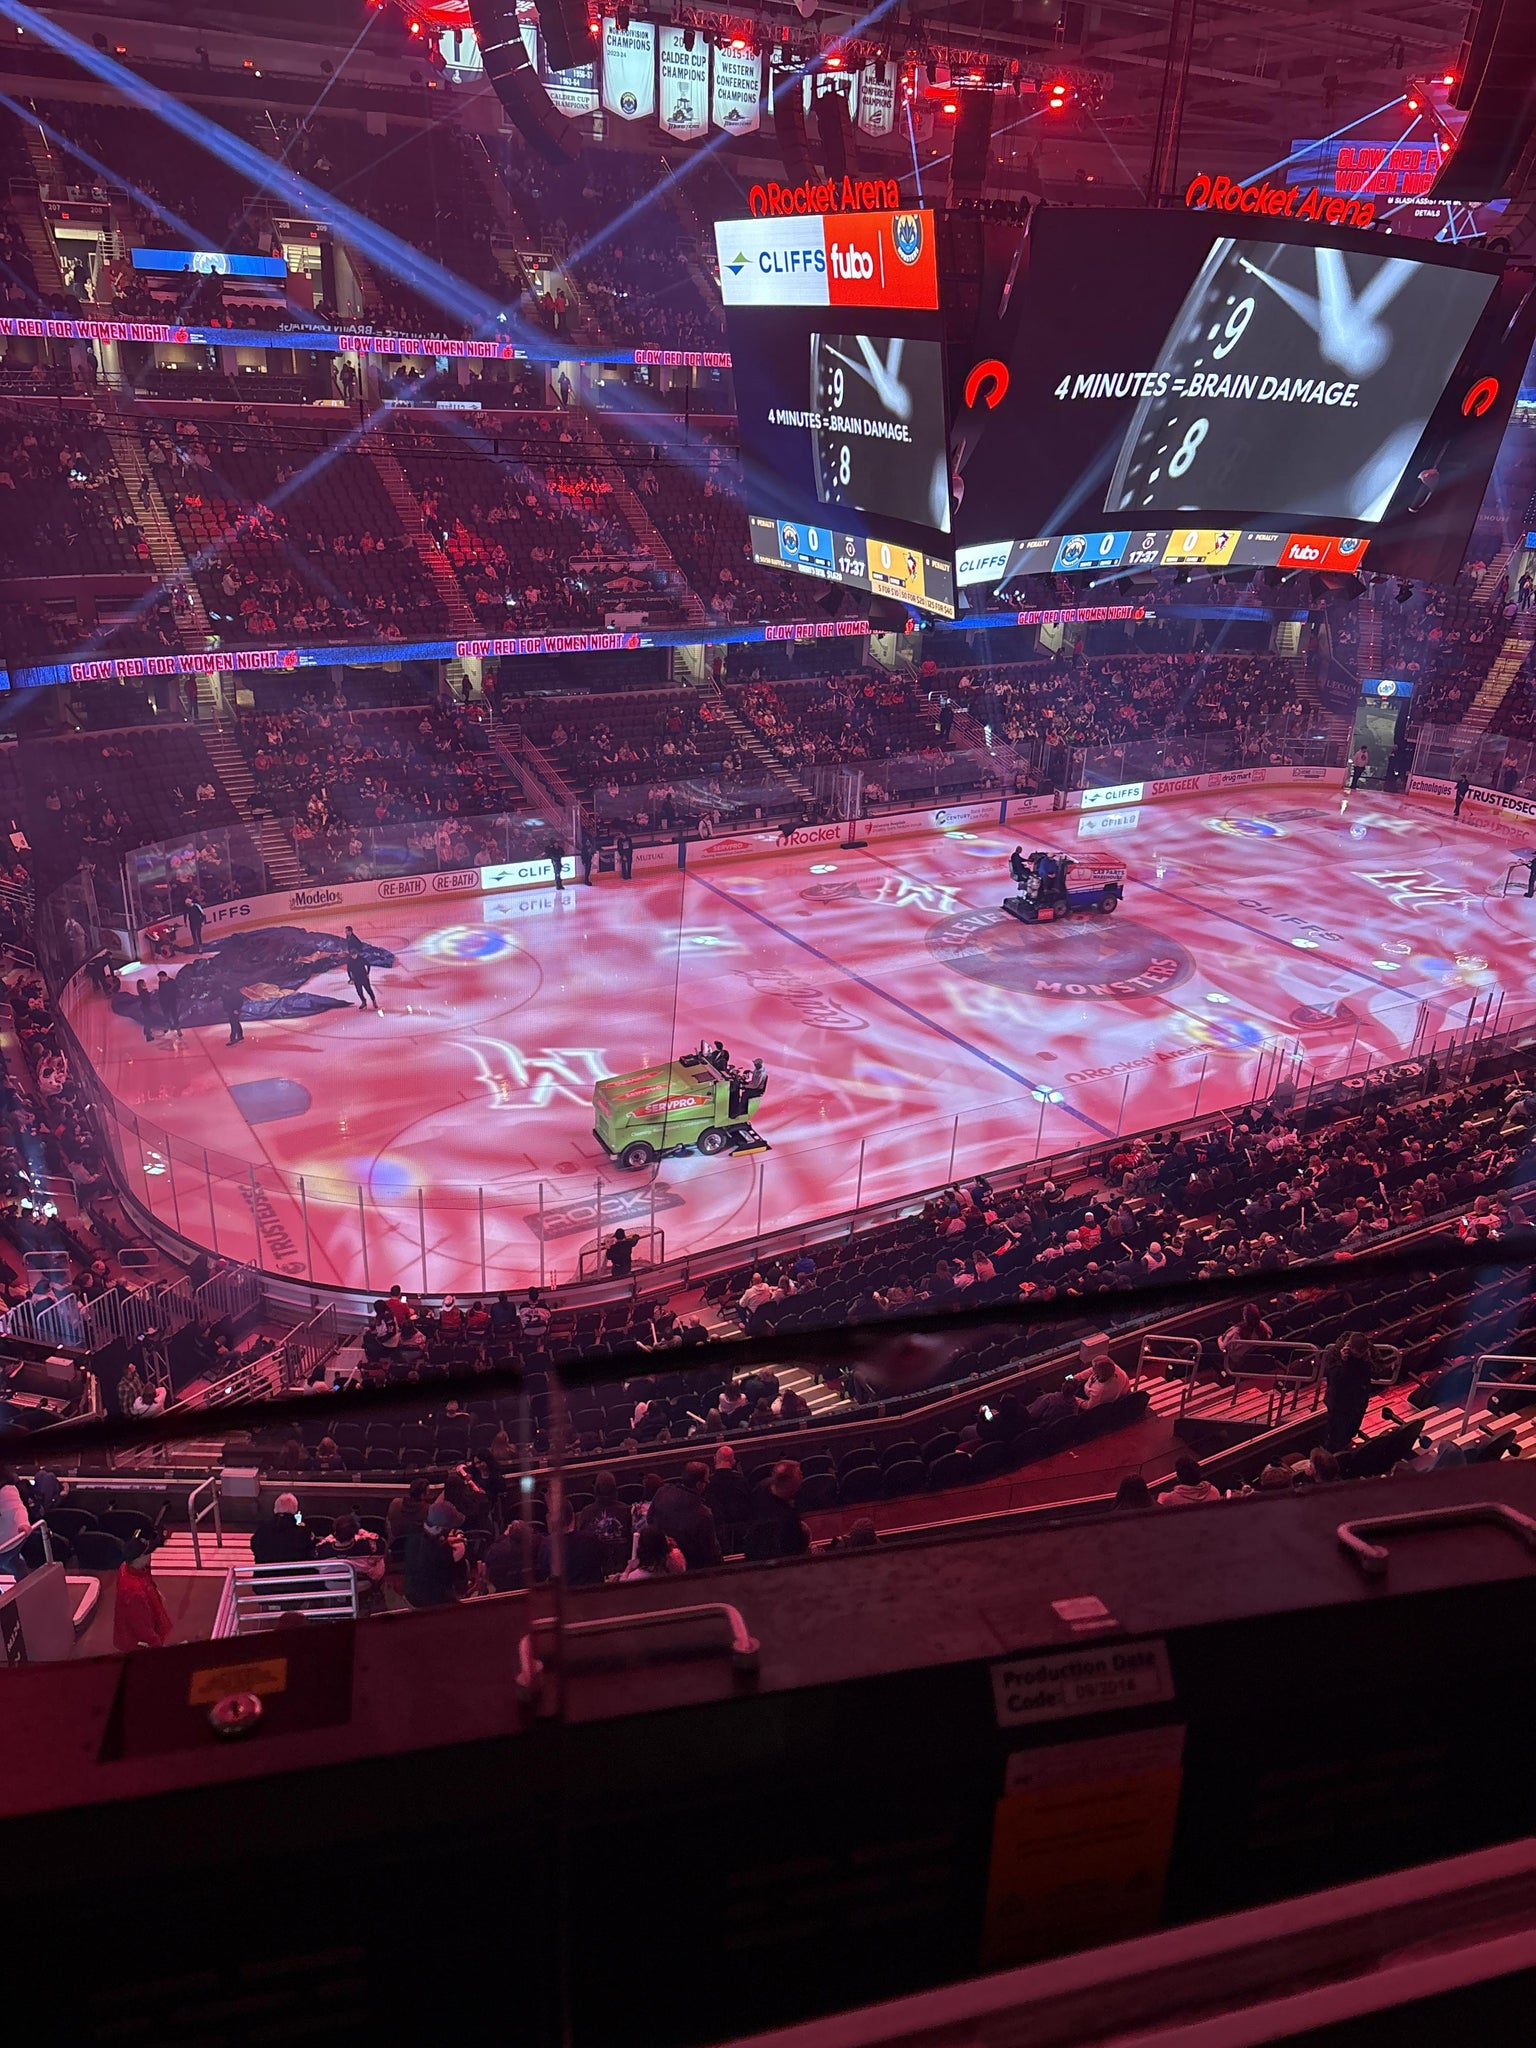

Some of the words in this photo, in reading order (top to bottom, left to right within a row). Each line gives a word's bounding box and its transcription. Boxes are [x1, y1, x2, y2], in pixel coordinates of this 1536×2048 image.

[606, 35, 651, 51] CHAMPIONS
[661, 50, 690, 66] CALDER
[691, 54, 707, 67] CUP
[662, 66, 706, 82] CHAMPIONS
[722, 62, 755, 77] WESTERN
[716, 75, 759, 91] CONFERENCE
[861, 87, 894, 98] CONFERENCE
[550, 92, 576, 103] CALDER
[577, 96, 590, 104] CUP
[717, 88, 757, 104] CHAMPIONS
[862, 97, 892, 108] CHAMPIONS
[1336, 147, 1389, 169] GLOW
[1388, 148, 1421, 170] RED
[1335, 171, 1397, 194] WOMEN
[1400, 171, 1435, 194] NIG
[767, 177, 837, 216] Rocket
[841, 175, 899, 211] Arena
[1208, 175, 1301, 219] Rocket
[1298, 187, 1376, 227] Arena
[48, 203, 61, 211] 207
[1414, 209, 1441, 217] DETAILS
[758, 249, 826, 274] CLIFFS
[830, 243, 874, 280] fubo
[17, 320, 42, 336] RED
[47, 320, 73, 338] FOR
[75, 321, 127, 341] WOMEN
[130, 323, 171, 342] NIGHT
[1213, 297, 1255, 360] 9
[339, 334, 371, 352] GLOW
[375, 338, 396, 353] RED
[399, 339, 420, 355] FOR
[422, 340, 464, 357] WOMEN
[466, 341, 499, 358] NIGHT
[634, 349, 662, 364] GLOW
[664, 350, 684, 366] RED
[685, 351, 702, 367] FOR
[703, 352, 733, 367] WOME
[833, 368, 844, 408] 9
[1054, 375, 1072, 400] 4
[1071, 372, 1171, 400] MINUTES
[1187, 372, 1259, 400] BRAIN
[1257, 377, 1360, 408] DAMAGE.
[768, 408, 775, 424] 4
[776, 409, 822, 429] MINUTES
[830, 415, 862, 435] BRAIN
[863, 419, 912, 443] DAMAGE.
[1168, 418, 1210, 478] 8
[839, 445, 850, 485] 8
[808, 528, 819, 552] 0
[1099, 533, 1114, 556] 0
[1183, 531, 1199, 552] 0
[881, 545, 891, 569] 0
[1128, 550, 1159, 564] 17:37
[1289, 543, 1320, 561] fubo
[839, 557, 865, 577] 17:37
[959, 555, 1007, 573] CLIFFS
[1018, 610, 1042, 625] GLOW
[1043, 610, 1058, 624] RED
[1059, 609, 1077, 623] FOR
[1077, 607, 1107, 622] WOMEN
[1107, 606, 1134, 621] NIGHT
[765, 624, 794, 640] GLOW
[794, 623, 814, 639] RED
[815, 622, 835, 637] FOR
[456, 640, 492, 658] GLOW
[493, 638, 517, 656] RED
[519, 637, 542, 655] FOR
[543, 635, 589, 653] WOMEN
[590, 633, 625, 650] NIGHT
[70, 660, 112, 682] GLOW
[114, 658, 144, 679] RED
[147, 656, 176, 676] FOR
[177, 652, 234, 674] WOMEN
[236, 650, 280, 670] NIGHT
[1152, 776, 1200, 796] SEATGEEK
[1221, 774, 1237, 783] drug
[1237, 772, 1251, 780] mart
[1410, 779, 1452, 796] Technologies
[1105, 787, 1140, 800] CLIFFS
[1467, 788, 1536, 816] TRUSTEDSEC
[946, 813, 970, 821] CENTURY
[713, 842, 743, 851] SERVPRO
[789, 825, 841, 847] Rocket
[635, 852, 665, 863] MUTUAL
[518, 862, 571, 879] CLIFS
[295, 890, 337, 906] Modelo
[204, 904, 251, 925] LIFFS
[1237, 898, 1345, 942] CLIFFS
[941, 912, 1001, 945] CLEVE
[1034, 957, 1178, 996] MONSTERS
[1085, 1056, 1158, 1079] Rocket
[1155, 1043, 1216, 1063] Arena
[1003, 1660, 1107, 1687] Production
[1111, 1651, 1156, 1672] Date
